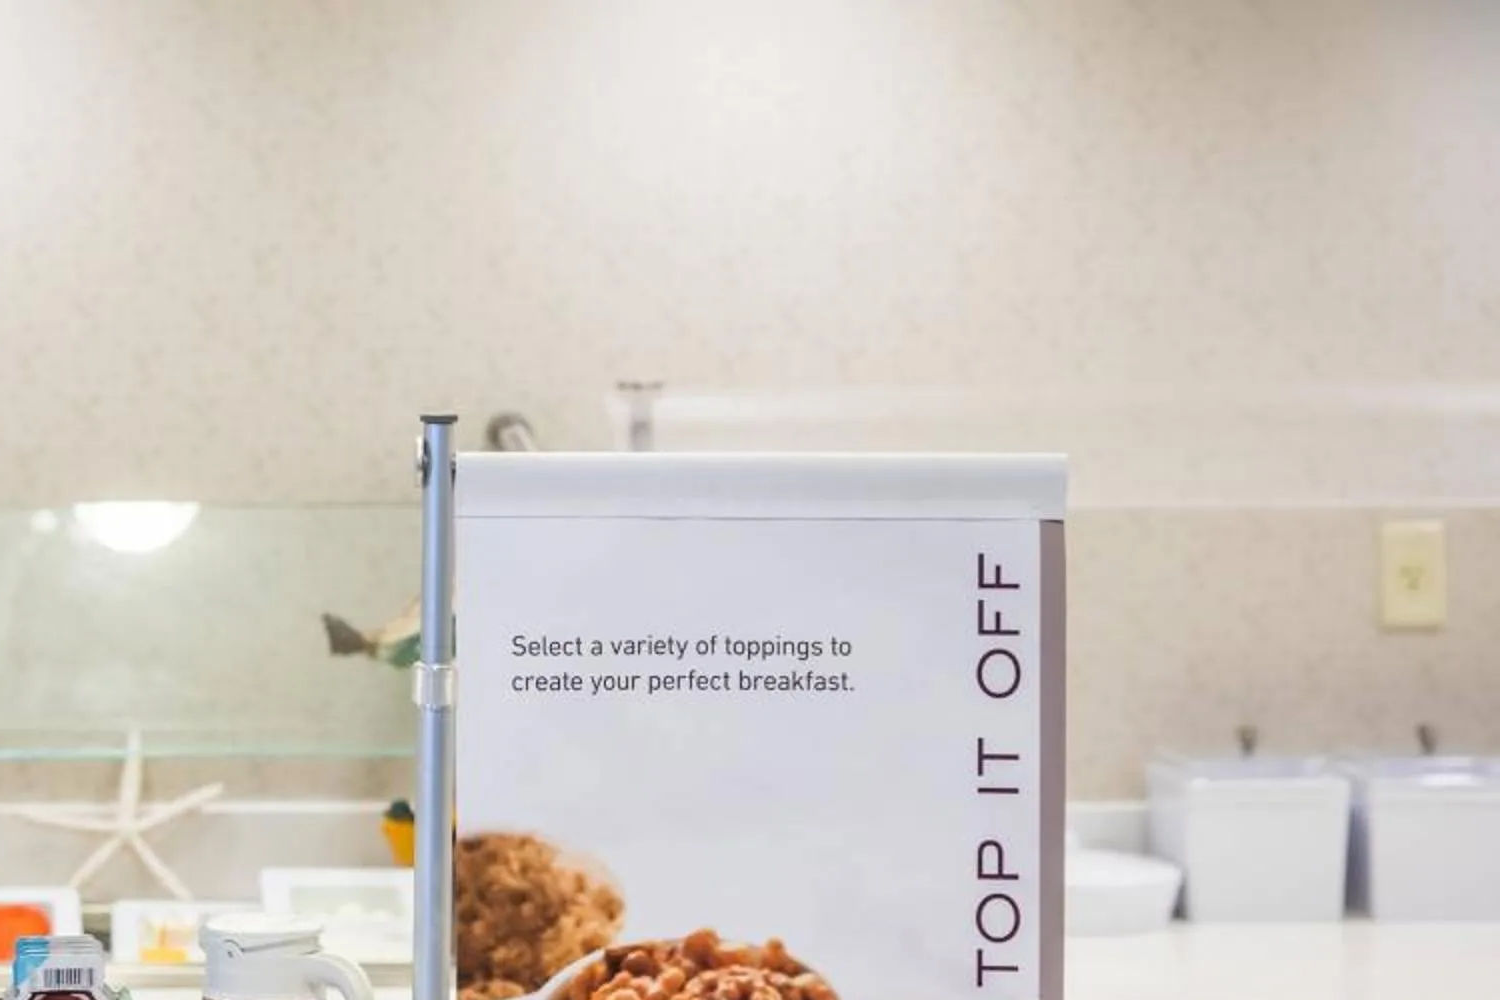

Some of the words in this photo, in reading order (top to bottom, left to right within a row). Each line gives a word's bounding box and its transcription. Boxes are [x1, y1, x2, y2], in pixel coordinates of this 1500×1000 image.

[512, 636, 583, 657] Select
[590, 641, 603, 656] a
[610, 636, 689, 659] variety
[695, 636, 717, 657] of
[724, 637, 824, 661] toppings
[830, 638, 852, 657] to
[976, 552, 1021, 698] OFF
[511, 672, 583, 692] create
[590, 675, 641, 696] your
[648, 671, 731, 694] perfect
[738, 671, 856, 692] breakfast.
[976, 737, 1020, 794] IT
[975, 839, 1021, 987] TOP
